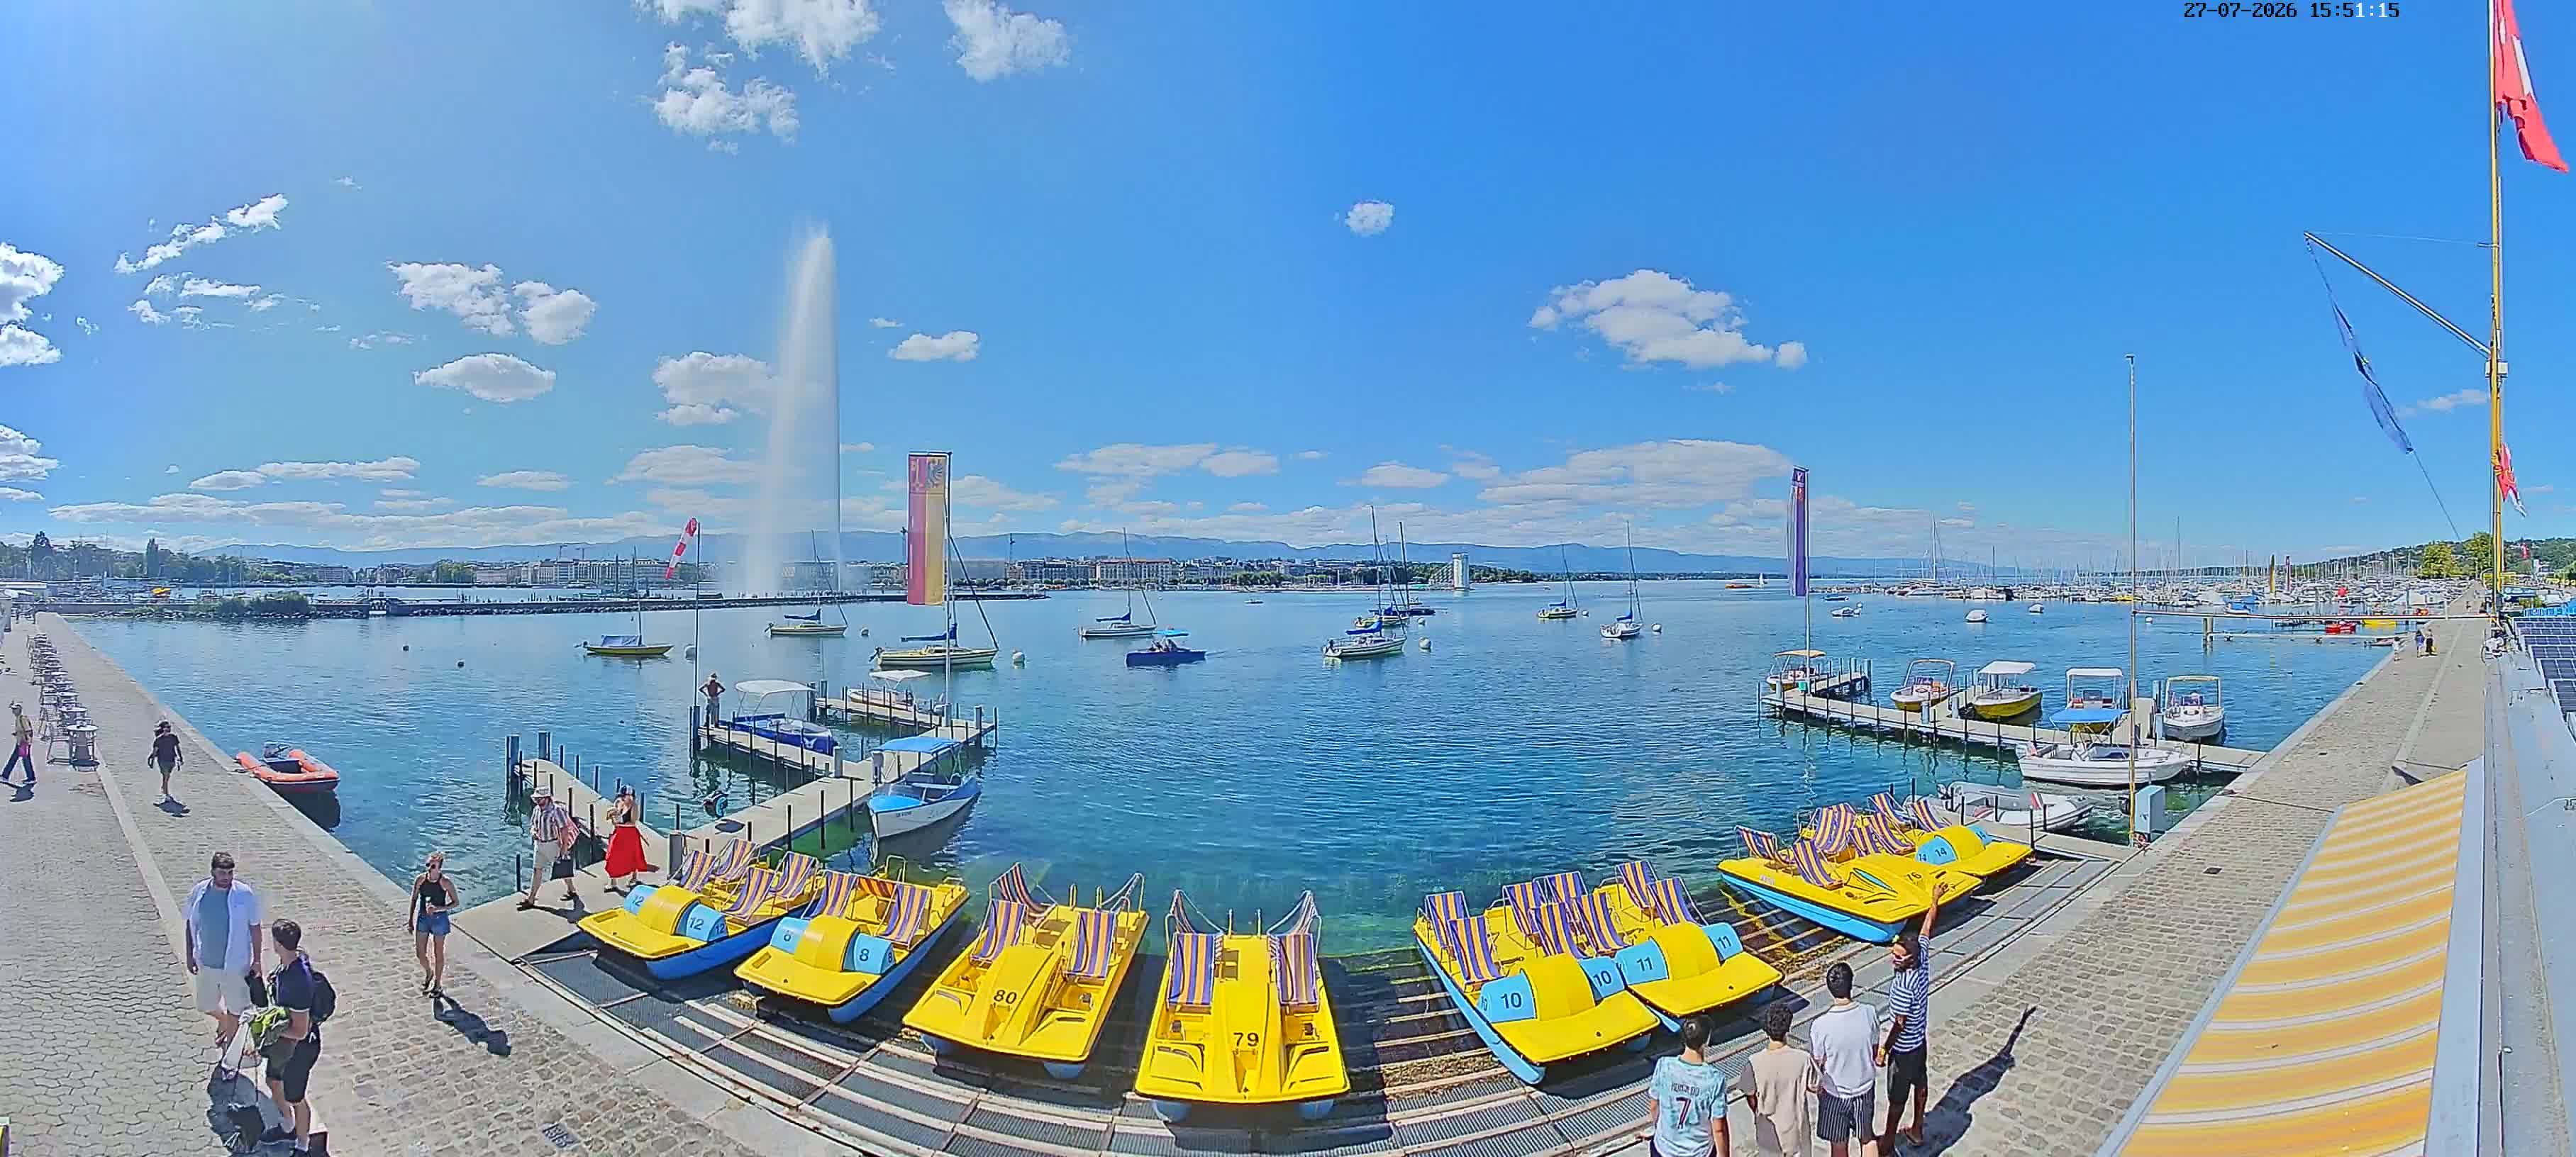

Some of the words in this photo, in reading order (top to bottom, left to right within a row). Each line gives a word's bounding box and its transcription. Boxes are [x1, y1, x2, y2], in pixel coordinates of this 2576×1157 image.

[1934, 847, 1948, 857] 14
[689, 917, 704, 931] 12
[715, 923, 725, 935] 12
[1718, 935, 1732, 949] 11
[859, 949, 869, 962] 8
[1636, 957, 1653, 972] 11
[1593, 971, 1612, 987] 10
[994, 990, 1017, 1005] 80
[1501, 993, 1522, 1010] 10
[1233, 1032, 1259, 1046] 79
[1676, 1097, 1692, 1129] 7
